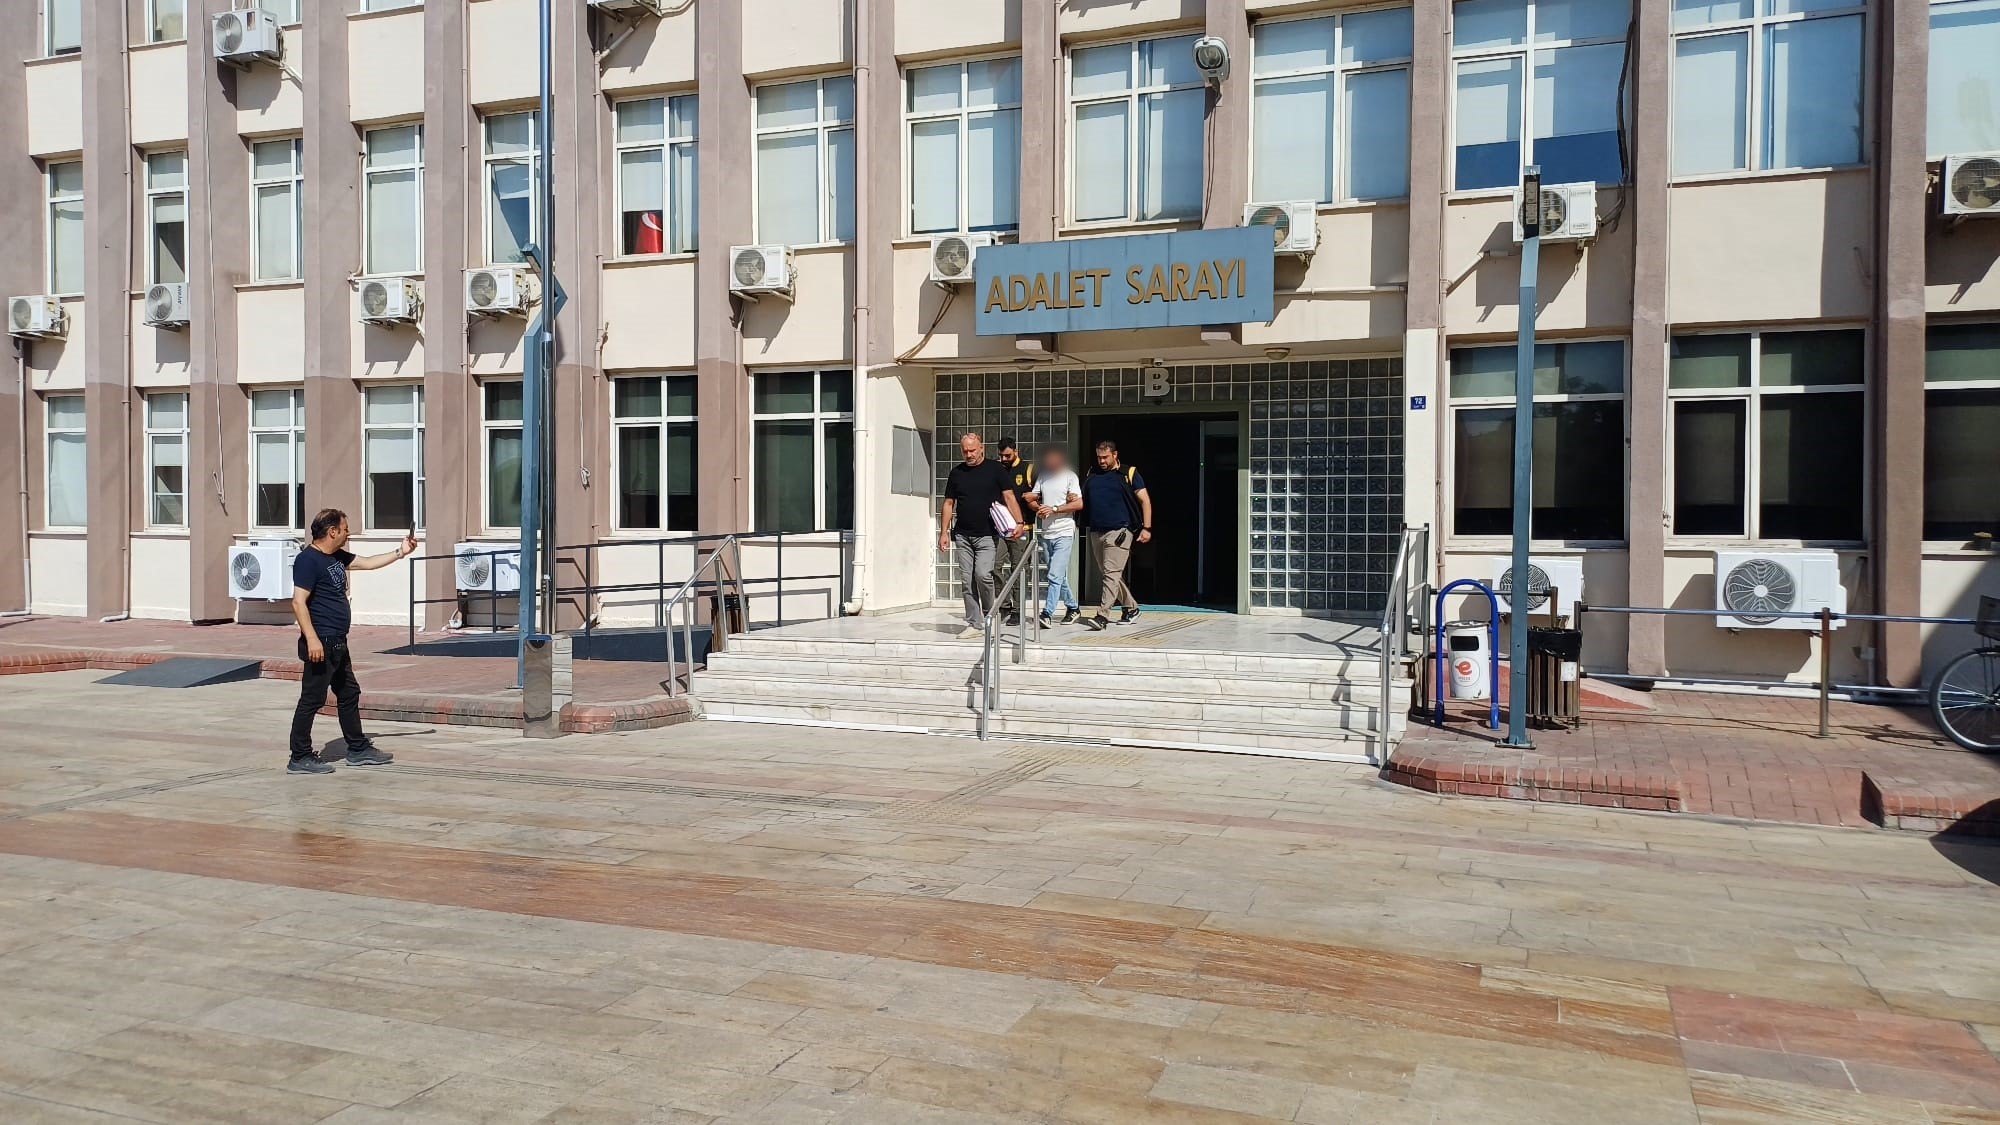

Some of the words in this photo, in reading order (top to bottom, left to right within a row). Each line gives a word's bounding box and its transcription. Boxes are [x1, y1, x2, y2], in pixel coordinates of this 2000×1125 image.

[984, 269, 1110, 313] ADALET
[1126, 258, 1246, 304] SARAYI
[1144, 367, 1171, 397] B
